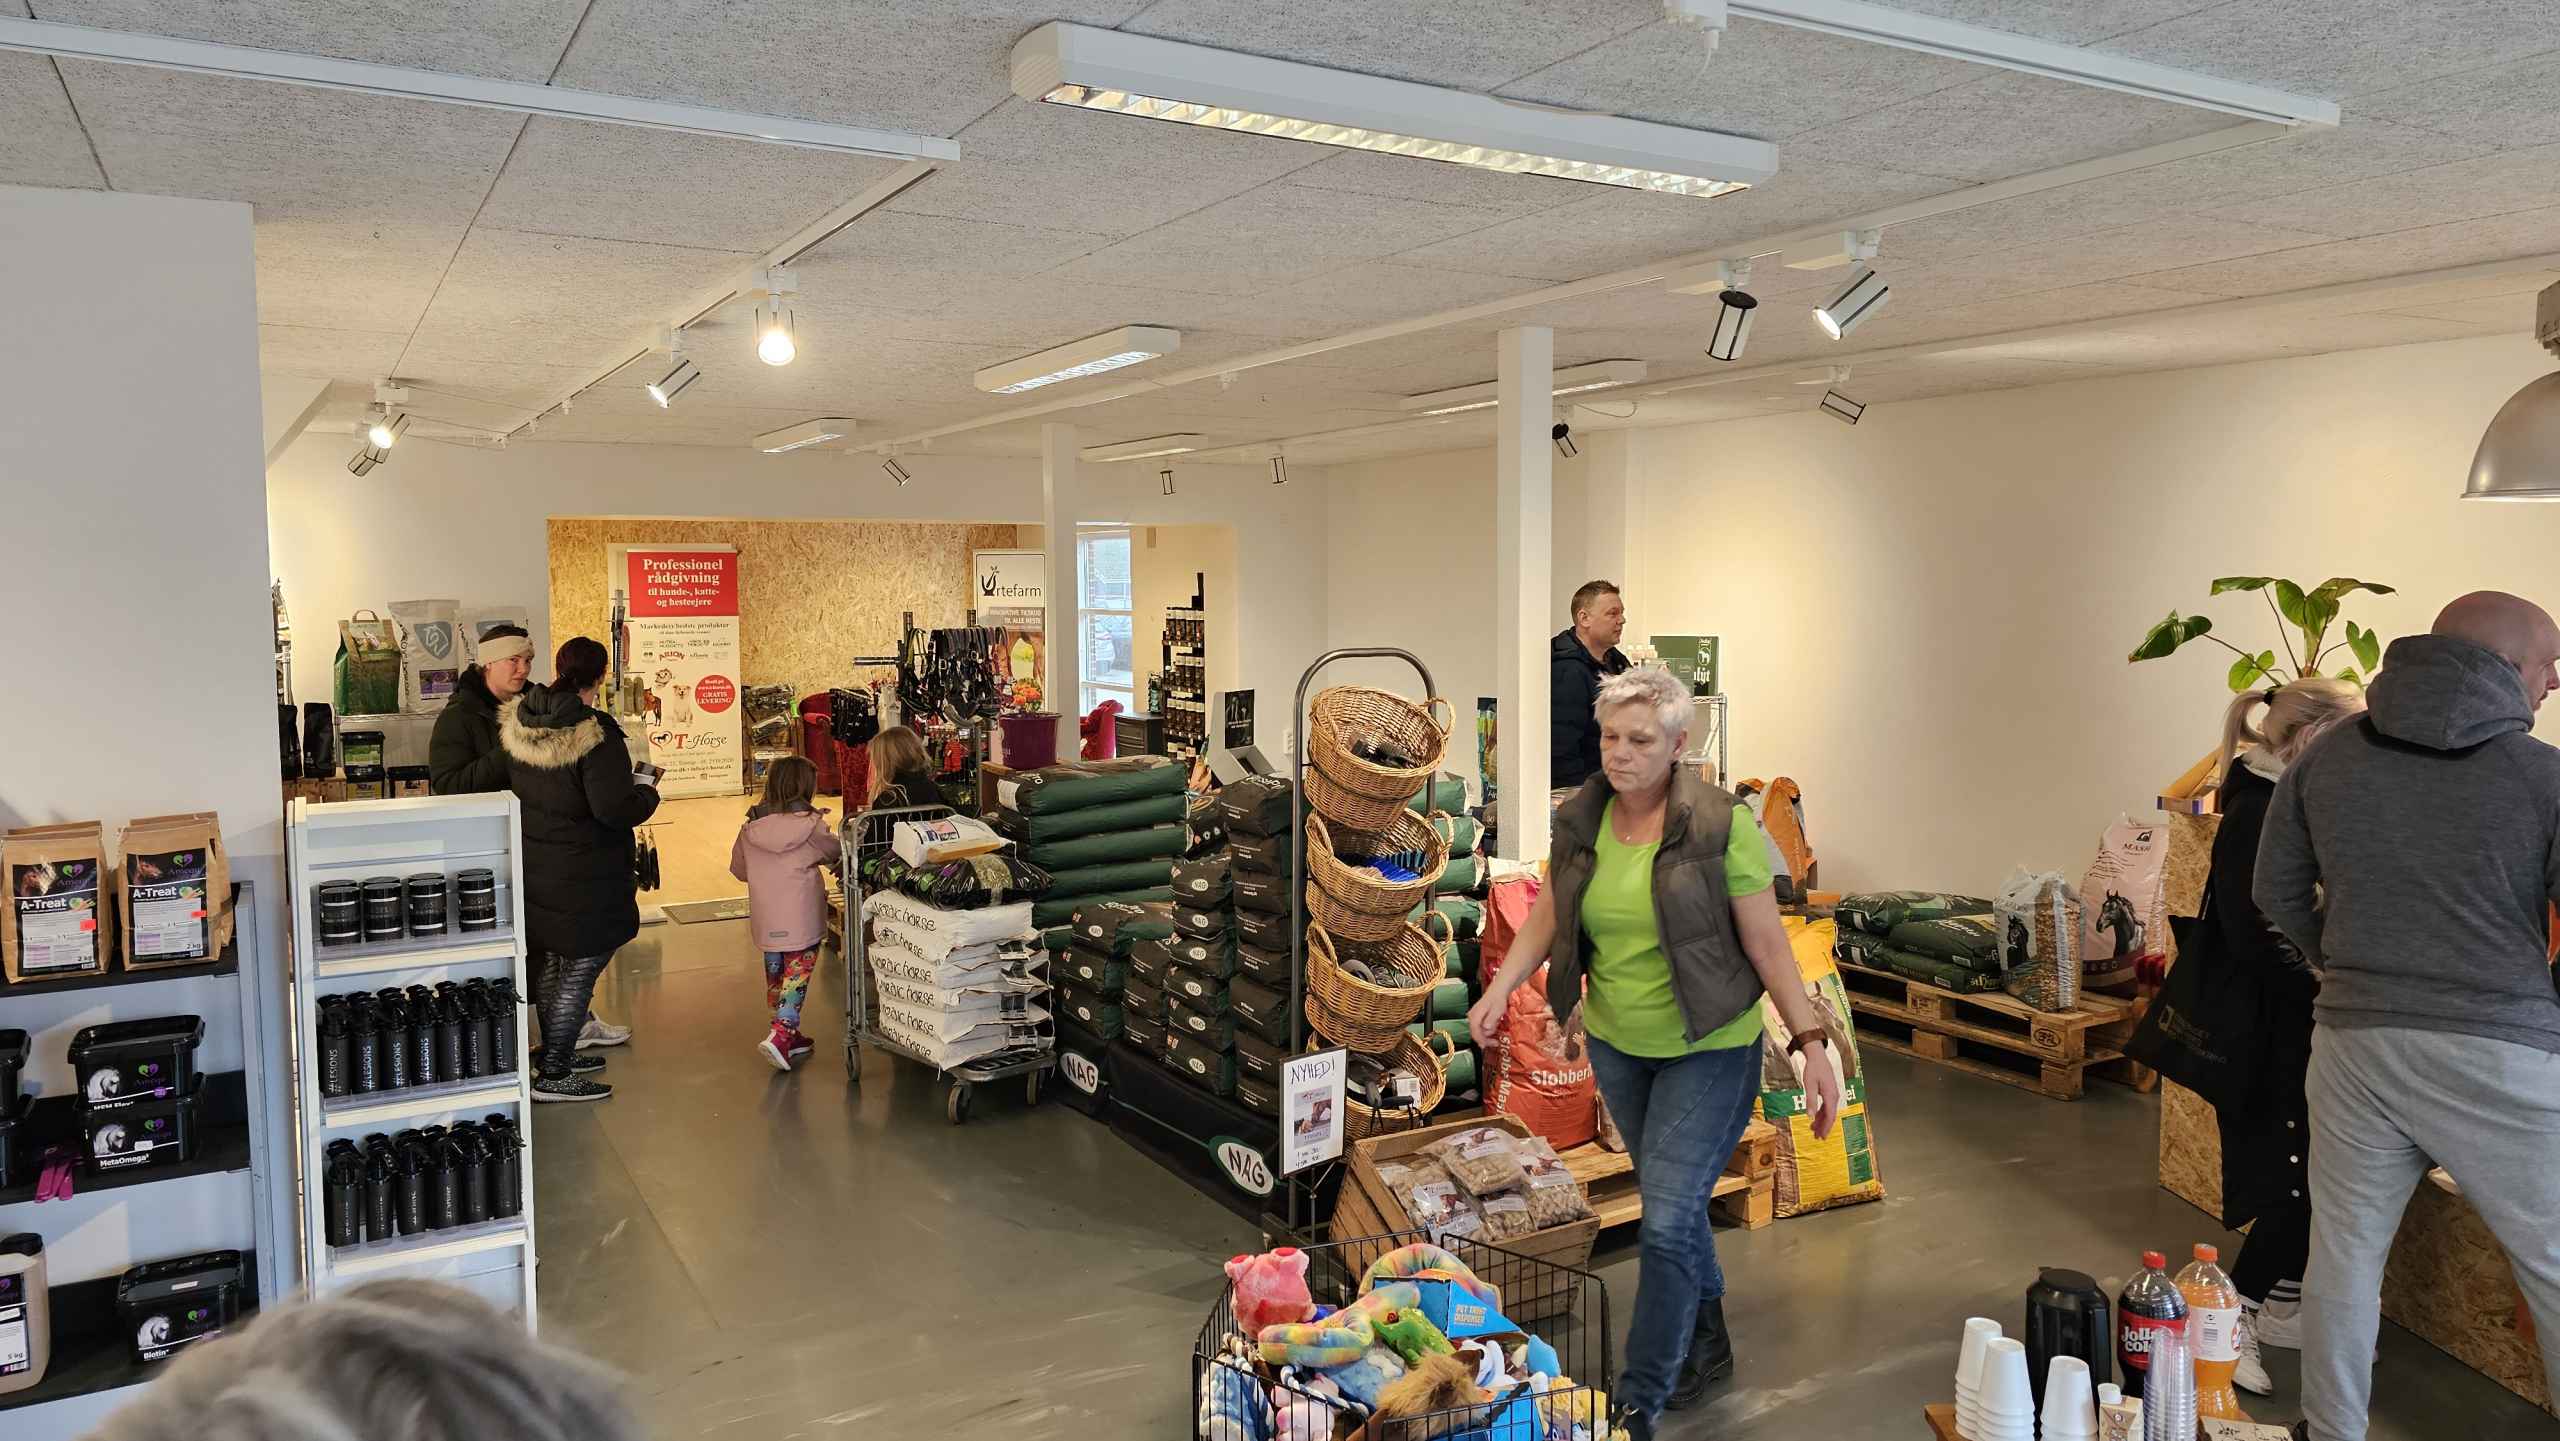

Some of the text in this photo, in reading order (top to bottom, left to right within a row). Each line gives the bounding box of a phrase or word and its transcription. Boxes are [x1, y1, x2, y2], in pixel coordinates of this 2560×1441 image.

[643, 559, 723, 570] Professionel
[648, 571, 720, 585] rådgivning
[648, 588, 720, 596] til hunde-, katte-
[656, 598, 713, 607] og hesteejere
[133, 886, 177, 899] A-Treat
[21, 897, 68, 911] A-Treat
[328, 1048, 342, 1094] #LESIONS
[1067, 1055, 1096, 1088] NAG
[1291, 1056, 1336, 1085] NYHED!
[1228, 1145, 1265, 1188] NAG
